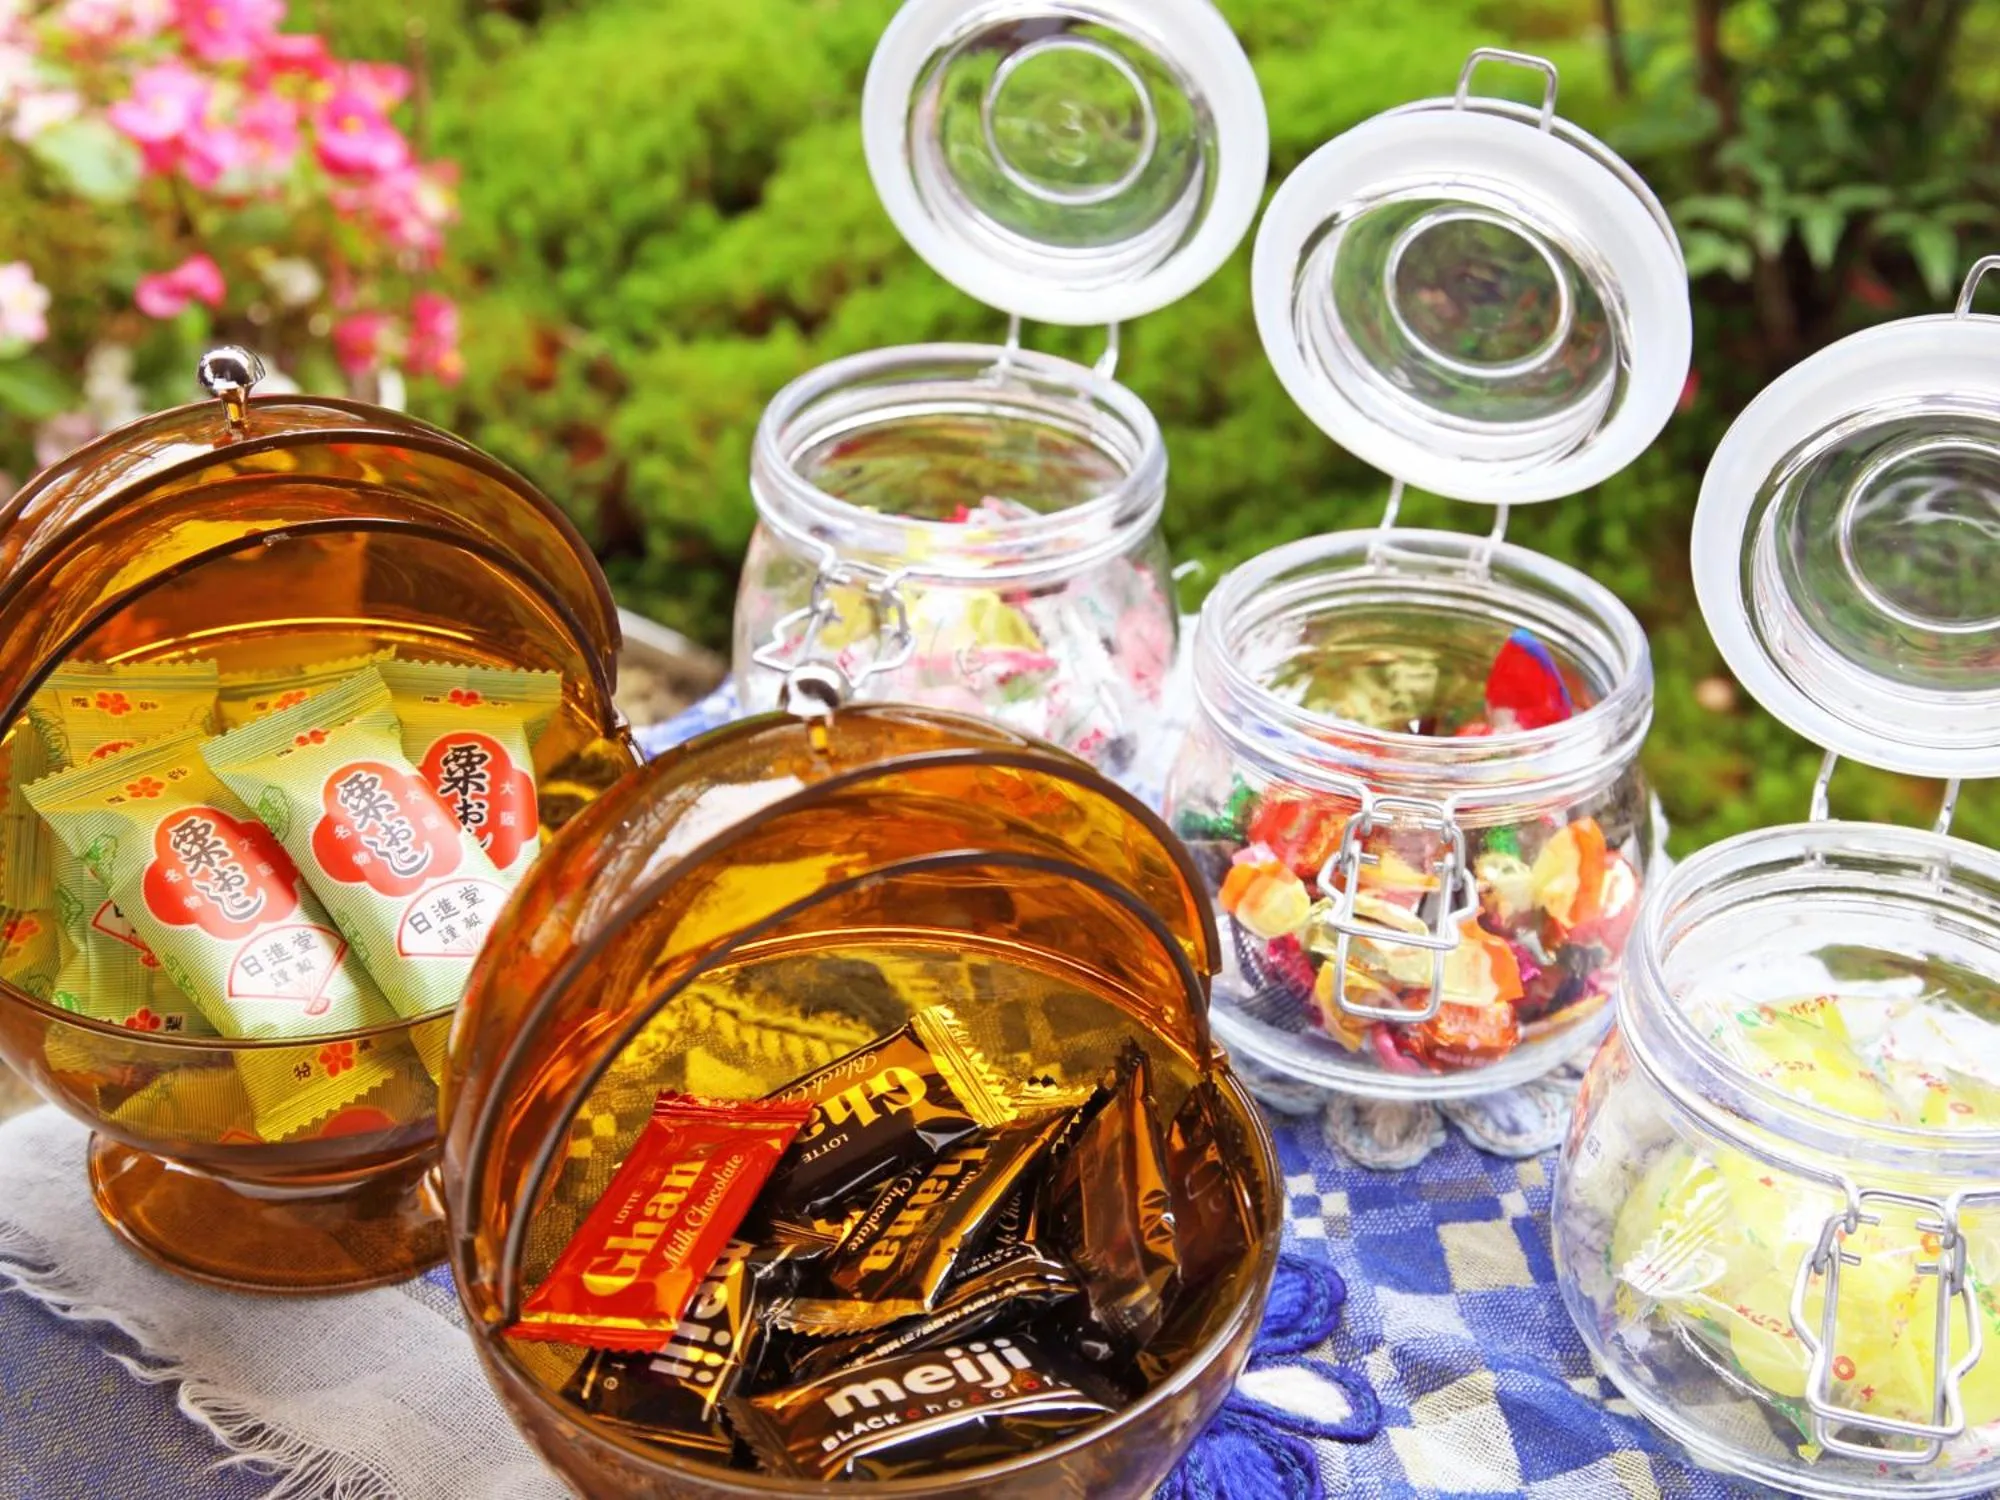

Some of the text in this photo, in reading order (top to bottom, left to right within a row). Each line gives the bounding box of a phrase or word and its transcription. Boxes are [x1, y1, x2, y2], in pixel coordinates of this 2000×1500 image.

[408, 883, 485, 935] 日進堂
[797, 1066, 927, 1142] Gha
[801, 1133, 849, 1164] LOTTE
[582, 1160, 707, 1296] Ghan
[662, 1153, 744, 1273] Milk Chocolate
[848, 1176, 914, 1252] Chocolate
[860, 1146, 990, 1276] hana
[823, 1338, 1032, 1418] meiji
[821, 1412, 901, 1452] BLACK
